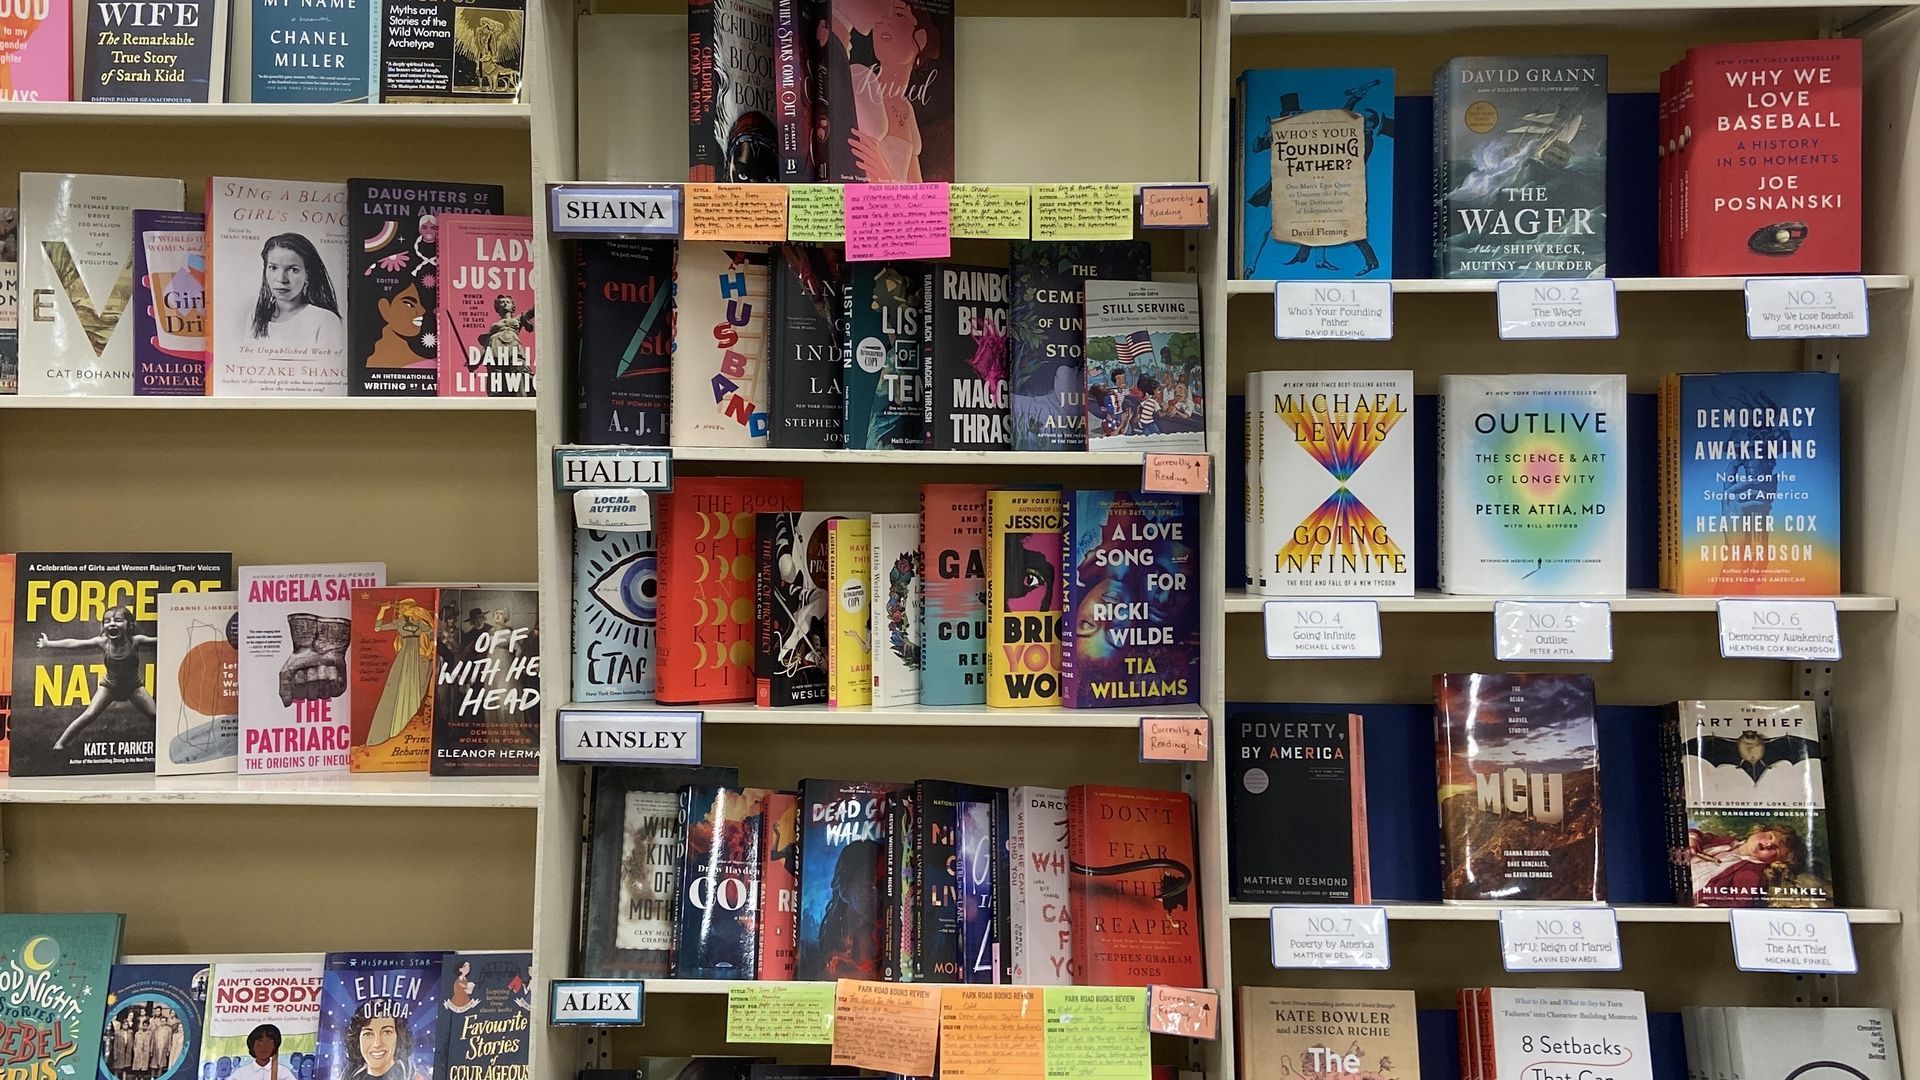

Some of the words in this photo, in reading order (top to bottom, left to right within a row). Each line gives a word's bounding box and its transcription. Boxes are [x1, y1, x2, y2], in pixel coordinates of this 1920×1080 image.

[97, 2, 199, 27] WIFE
[389, 5, 416, 17] Myths
[389, 16, 419, 27] Stories
[97, 31, 121, 46] The
[123, 33, 195, 46] Remarkable
[270, 30, 349, 46] CHANEL
[389, 27, 411, 37] Wild
[414, 28, 451, 38] Woman
[388, 38, 435, 50] Archetype
[111, 50, 141, 64] True
[143, 51, 177, 67] Story
[274, 53, 345, 69] MILLER
[116, 69, 151, 83] Sarah
[154, 69, 185, 82] Kidd
[1461, 69, 1519, 83] DAVID
[1526, 68, 1596, 83] GRANN
[1725, 70, 1783, 87] WHY
[1794, 67, 1832, 85] WE
[851, 62, 938, 106] Ruined
[1747, 91, 1810, 109] LOVE
[1717, 111, 1841, 132] BASEBALL
[1275, 129, 1318, 140] WHO'S
[1322, 128, 1358, 138] YOUR
[1274, 138, 1360, 161] FOUNDING
[1752, 138, 1821, 149] HISTORY
[1284, 158, 1352, 177] FATHER?
[1739, 156, 1756, 166] 50
[1764, 154, 1839, 166] MOMENTS
[1758, 175, 1798, 190] JOE
[367, 186, 467, 203] DAUGHTERS
[1149, 193, 1193, 207] Currently
[1507, 187, 1548, 202] THE
[363, 202, 411, 216] LATIN
[566, 200, 666, 220] SHAINA
[1714, 194, 1841, 212] POSNANSKI
[1149, 208, 1183, 220] Reading
[1457, 207, 1596, 236] WAGER
[1291, 228, 1315, 237] David
[1316, 227, 1348, 238] Fleming
[1503, 244, 1585, 256] SHIPWRECK,
[1072, 264, 1098, 277] THE
[1459, 261, 1517, 271] MUTINY
[1534, 260, 1592, 271] MURDER
[924, 273, 932, 316] RAINBOW
[1315, 287, 1345, 302] NO.
[1102, 304, 1134, 315] STILL
[1137, 303, 1186, 313] SERVING
[1339, 307, 1383, 318] Founding
[1551, 308, 1583, 319] Wager
[1821, 311, 1854, 320] Baseball
[924, 317, 932, 343] BLACK
[1329, 329, 1365, 337] FLEMING
[1793, 323, 1840, 331] POSNANSKI
[46, 369, 72, 379] CAT
[924, 356, 932, 388] MAGGIE
[364, 381, 406, 391] WRITING
[924, 389, 932, 423] THRASH
[1273, 393, 1408, 414] MICHAEL
[784, 417, 841, 428] STEPHEN
[1474, 412, 1607, 434] OUTLIVE
[1697, 407, 1816, 429] DEMOCRACY
[1293, 422, 1388, 442] LEWIS
[1695, 439, 1817, 460] AWAKENING
[1476, 454, 1499, 463] THE
[1505, 453, 1565, 463] SCIENCE
[1582, 453, 1606, 462] ART
[567, 461, 662, 483] HALLI
[1486, 475, 1503, 484] OF
[1512, 474, 1595, 484] LONGEVITY
[1716, 472, 1753, 482] Notes
[1703, 490, 1736, 501] State
[1756, 490, 1809, 500] America
[590, 505, 637, 513] AUTHOR
[1062, 501, 1070, 528] TIA
[1476, 504, 1520, 515] PETER
[1528, 504, 1576, 516] ATTIA,
[1582, 504, 1606, 515] MD
[1696, 515, 1775, 532] HEATHER
[1784, 515, 1817, 532] COX
[1111, 523, 1126, 541] A
[1131, 523, 1183, 541] LOVE
[1293, 525, 1389, 546] GOING
[1095, 549, 1154, 567] SONG
[1700, 544, 1813, 563] RICHARDSON
[1274, 554, 1407, 574] INFINITE
[1062, 531, 1070, 613] WILLIAMS
[1147, 574, 1186, 591] FOR
[248, 579, 321, 603] ANGELA
[1093, 602, 1149, 621] RICKI
[1754, 611, 1785, 626] NO.
[1790, 613, 1800, 626] 6
[474, 627, 529, 654] OFF
[1109, 627, 1174, 646] WILDE
[1293, 630, 1321, 642] Going
[1323, 630, 1356, 640] Infinite
[1535, 634, 1568, 645] Outlive
[1728, 632, 1780, 644] Democracy
[1783, 633, 1834, 645] Awakening
[1124, 657, 1157, 675] TIA
[438, 661, 501, 687] WITH
[1090, 679, 1189, 699] WILLIAMS
[292, 699, 332, 723] THE
[1151, 723, 1190, 737] Currently
[1696, 717, 1733, 727] ART
[1744, 718, 1804, 728] THIEF
[1241, 723, 1345, 740] POVERTY,
[577, 731, 688, 749] AINSLEY
[1150, 737, 1189, 751] Reading
[84, 742, 108, 756] KATE
[118, 741, 154, 756] PARKER
[437, 748, 496, 759] ELEANOR
[1241, 746, 1262, 759] BY
[1269, 747, 1344, 760] AMERICA
[266, 757, 306, 769] ORIGINS
[1475, 767, 1564, 825] MCU
[812, 797, 861, 823] DEAD
[1100, 804, 1175, 825] DON'T
[1108, 841, 1169, 860] FEAR
[1243, 876, 1293, 886] MATTHEW
[1298, 877, 1348, 887] DESMOND
[1702, 886, 1768, 896] MICHAEL
[1774, 886, 1827, 896] FINKEL
[1094, 916, 1190, 936] REAPER
[1339, 939, 1375, 949] America
[1803, 944, 1827, 955] Thief
[1145, 954, 1193, 964] GRAHAM
[1559, 955, 1597, 963] EDWARDS
[1765, 957, 1801, 965] MICHAEL
[1127, 967, 1161, 977] JONES
[218, 977, 251, 986] AIN'T
[253, 977, 300, 986] GONNA
[354, 975, 422, 1001] ELLEN
[216, 986, 323, 1004] NOBODY
[857, 985, 873, 993] PARK
[909, 989, 931, 998] REVIEW
[215, 1005, 250, 1014] TURN
[561, 992, 633, 1012] ALEX
[363, 1002, 409, 1019] OCHOA
[1275, 1009, 1317, 1023] KATE
[1321, 1010, 1391, 1024] BOWLER
[461, 1010, 528, 1041] Favourite
[1293, 1025, 1345, 1036] JESSICA
[1347, 1026, 1391, 1037] RICHIE
[465, 1036, 520, 1060] Stories
[1521, 1035, 1534, 1053] 8
[1541, 1035, 1622, 1057] Setbacks
[1308, 1046, 1361, 1074] The
